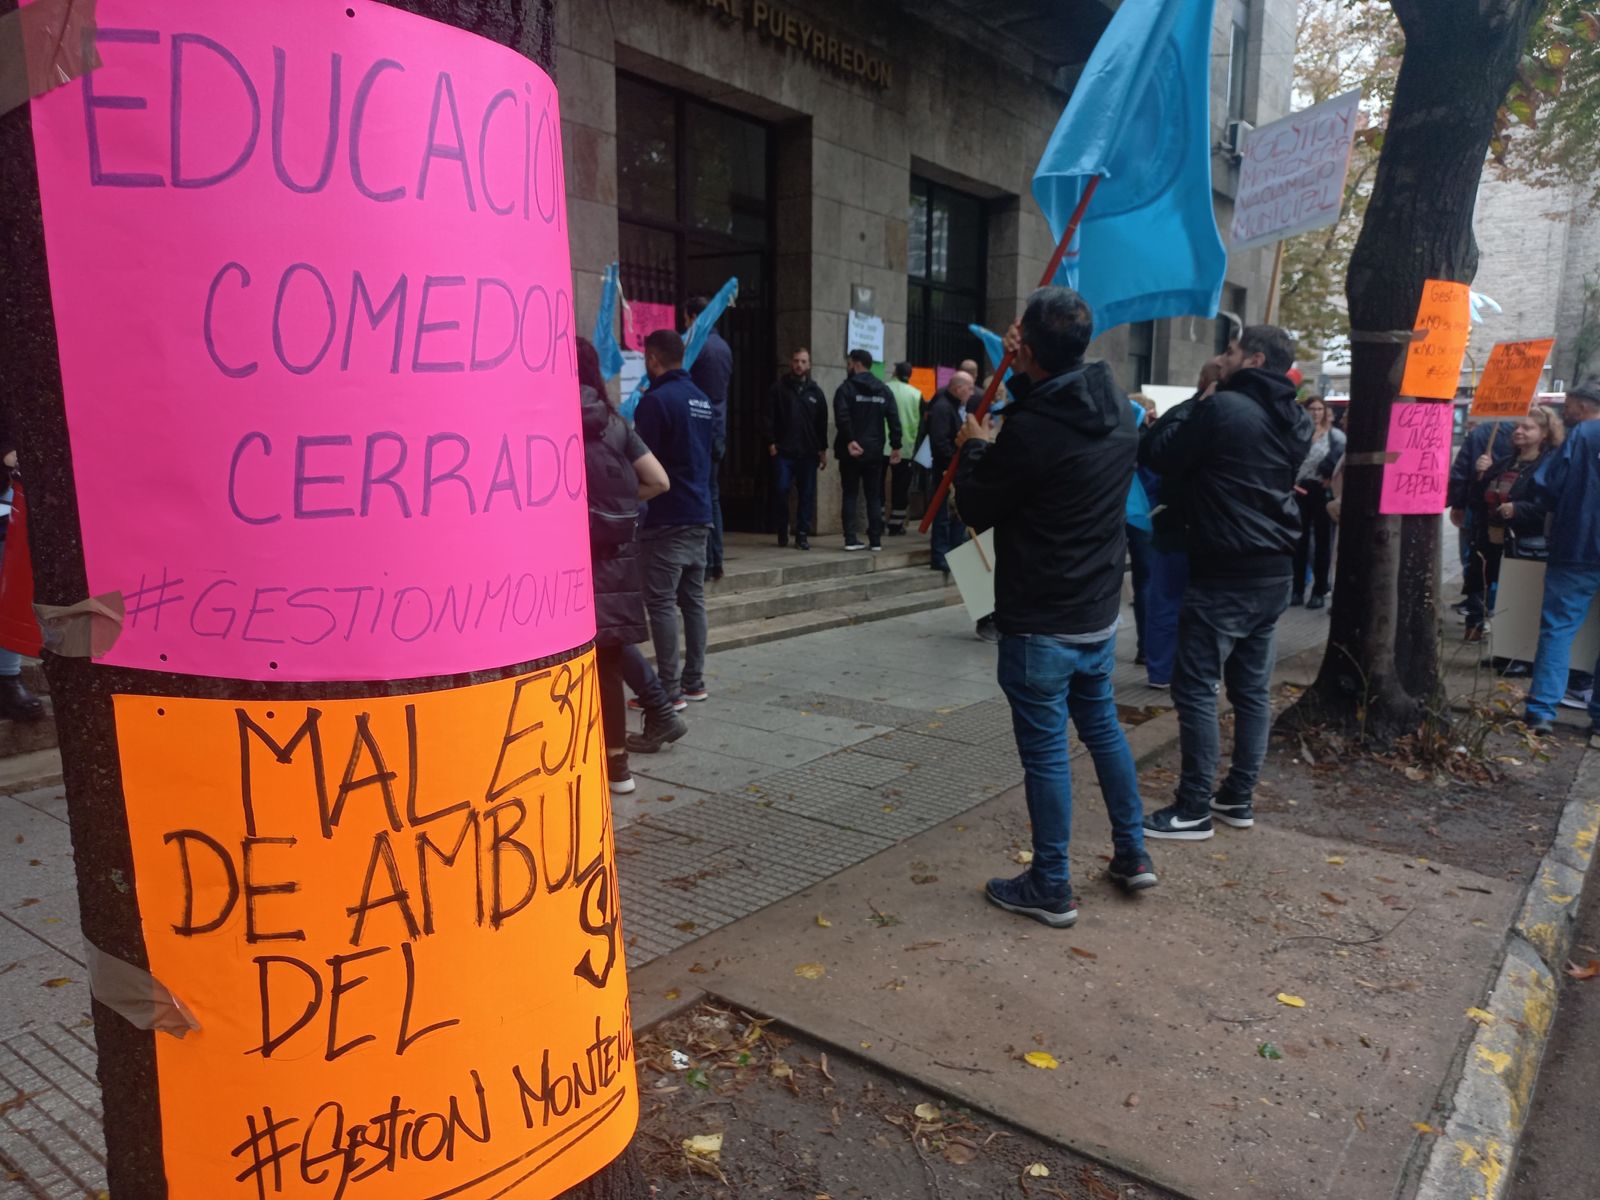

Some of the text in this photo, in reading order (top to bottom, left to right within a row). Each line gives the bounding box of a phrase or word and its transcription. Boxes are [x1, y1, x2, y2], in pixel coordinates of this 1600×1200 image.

[753, 1, 893, 87] PUEYRREDON
[203, 261, 573, 379] COMEDOR
[228, 431, 586, 525] CERRADO
[1417, 451, 1440, 472] EN
[234, 704, 472, 839] MAL
[163, 828, 306, 944] DE
[244, 942, 461, 1060] DEL
